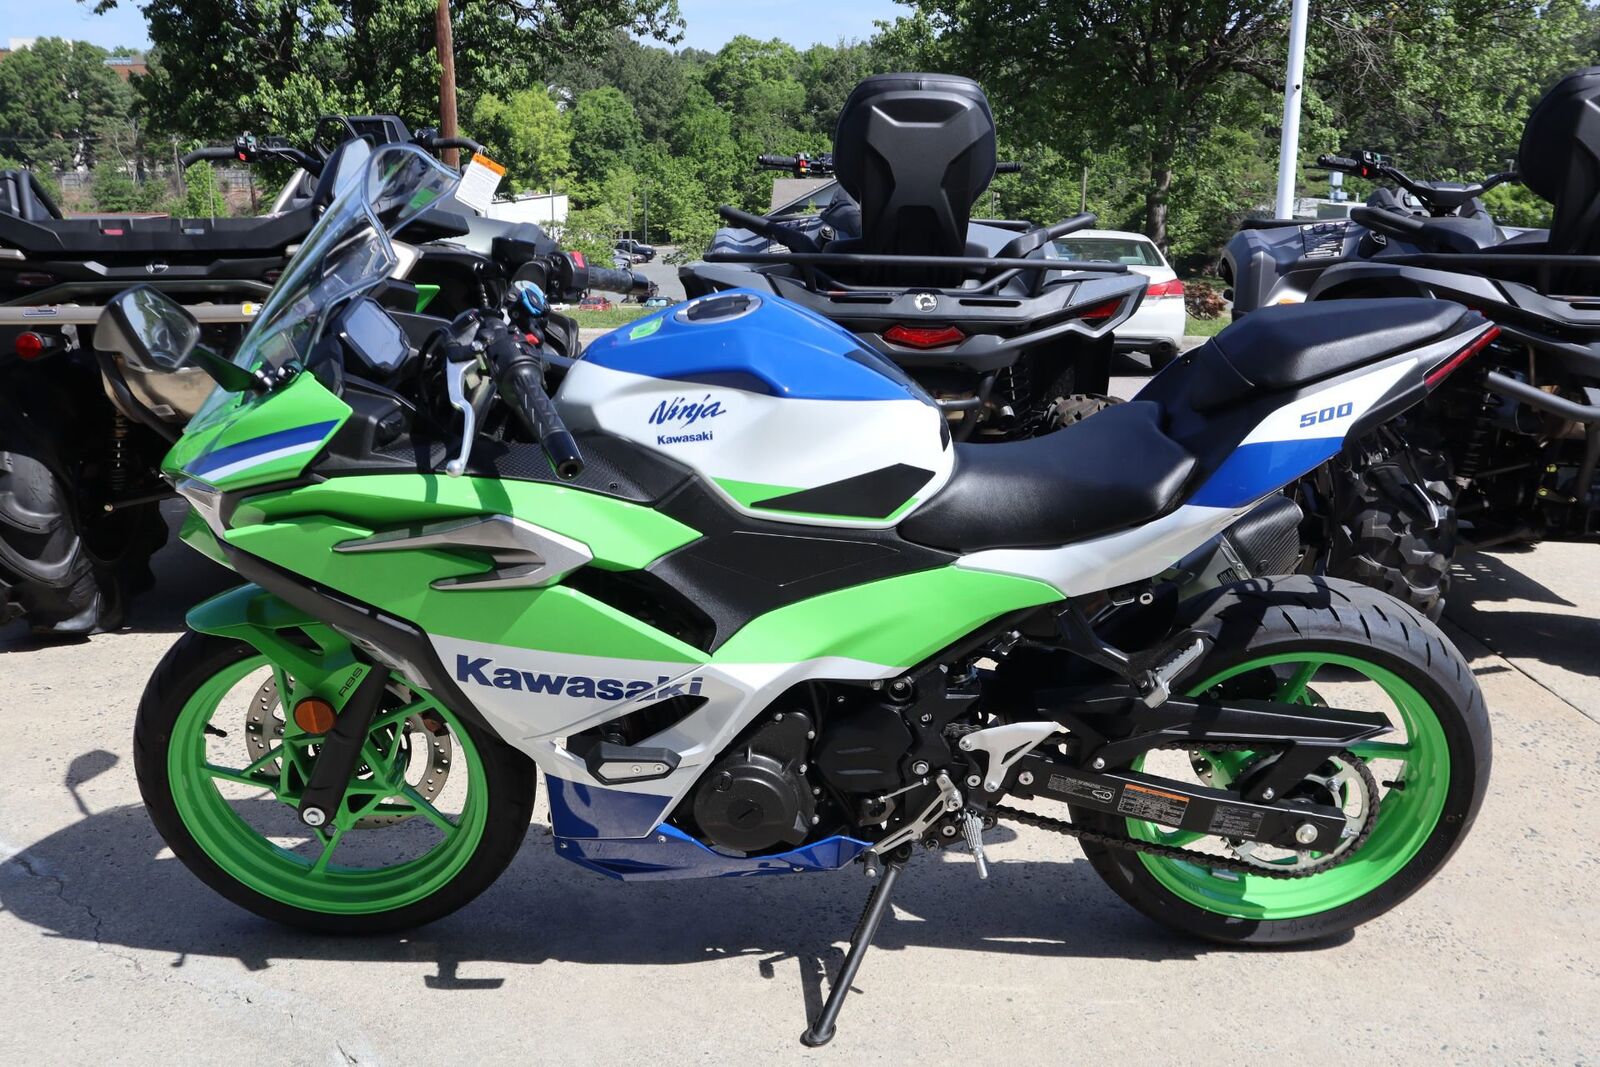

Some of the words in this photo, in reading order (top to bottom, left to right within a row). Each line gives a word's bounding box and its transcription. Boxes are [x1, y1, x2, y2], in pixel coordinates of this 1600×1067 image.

[648, 394, 726, 429] Ninja
[1300, 402, 1353, 428] 500
[657, 430, 713, 445] Kawasaki
[339, 667, 362, 697] ABS
[456, 654, 703, 702] Kawasaki
